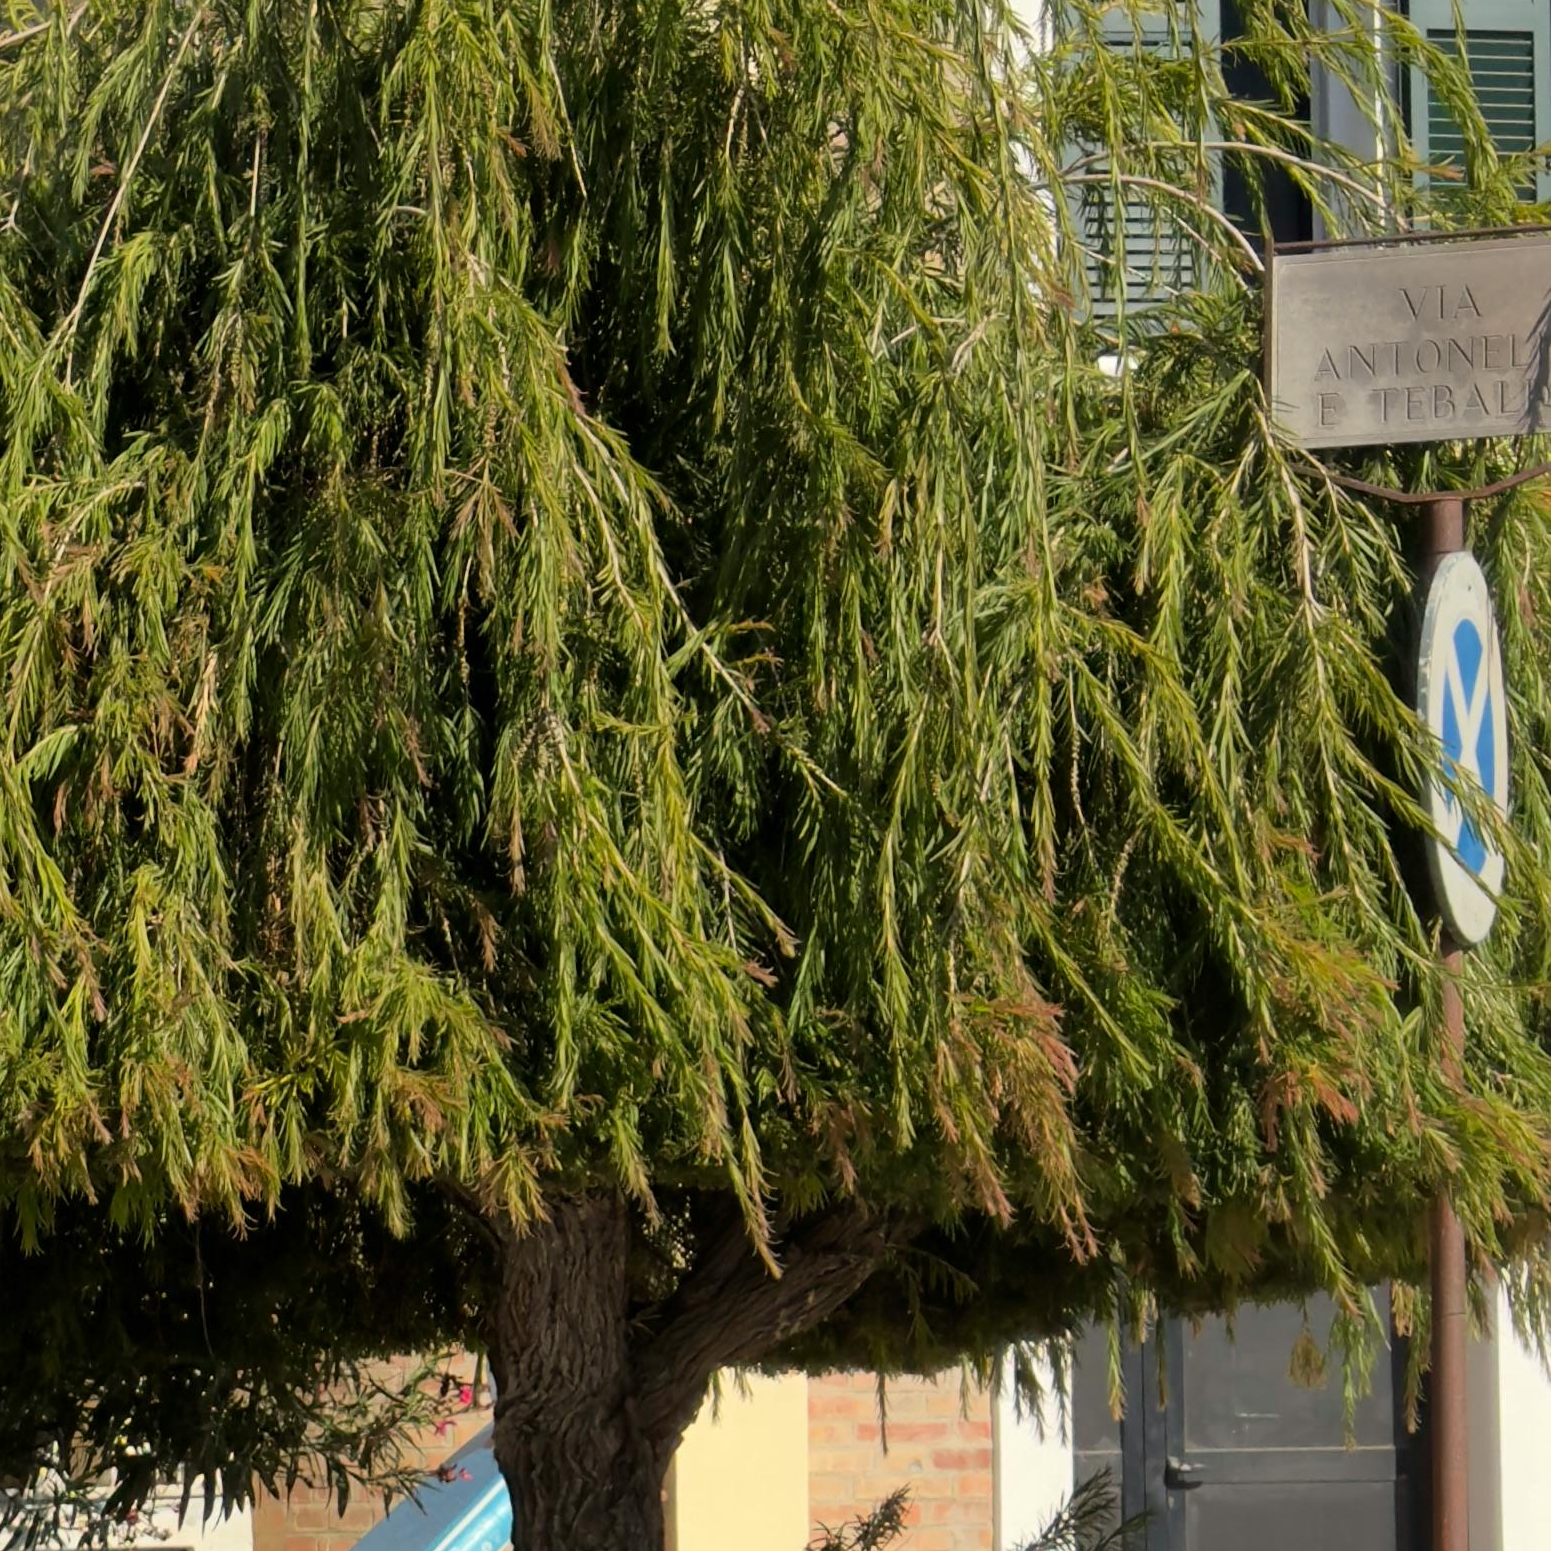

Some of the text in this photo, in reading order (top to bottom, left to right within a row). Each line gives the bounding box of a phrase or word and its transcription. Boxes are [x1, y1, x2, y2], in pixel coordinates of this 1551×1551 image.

[1399, 283, 1482, 322] VIA
[1314, 333, 1546, 382] ANTONEL
[1317, 392, 1342, 428] E
